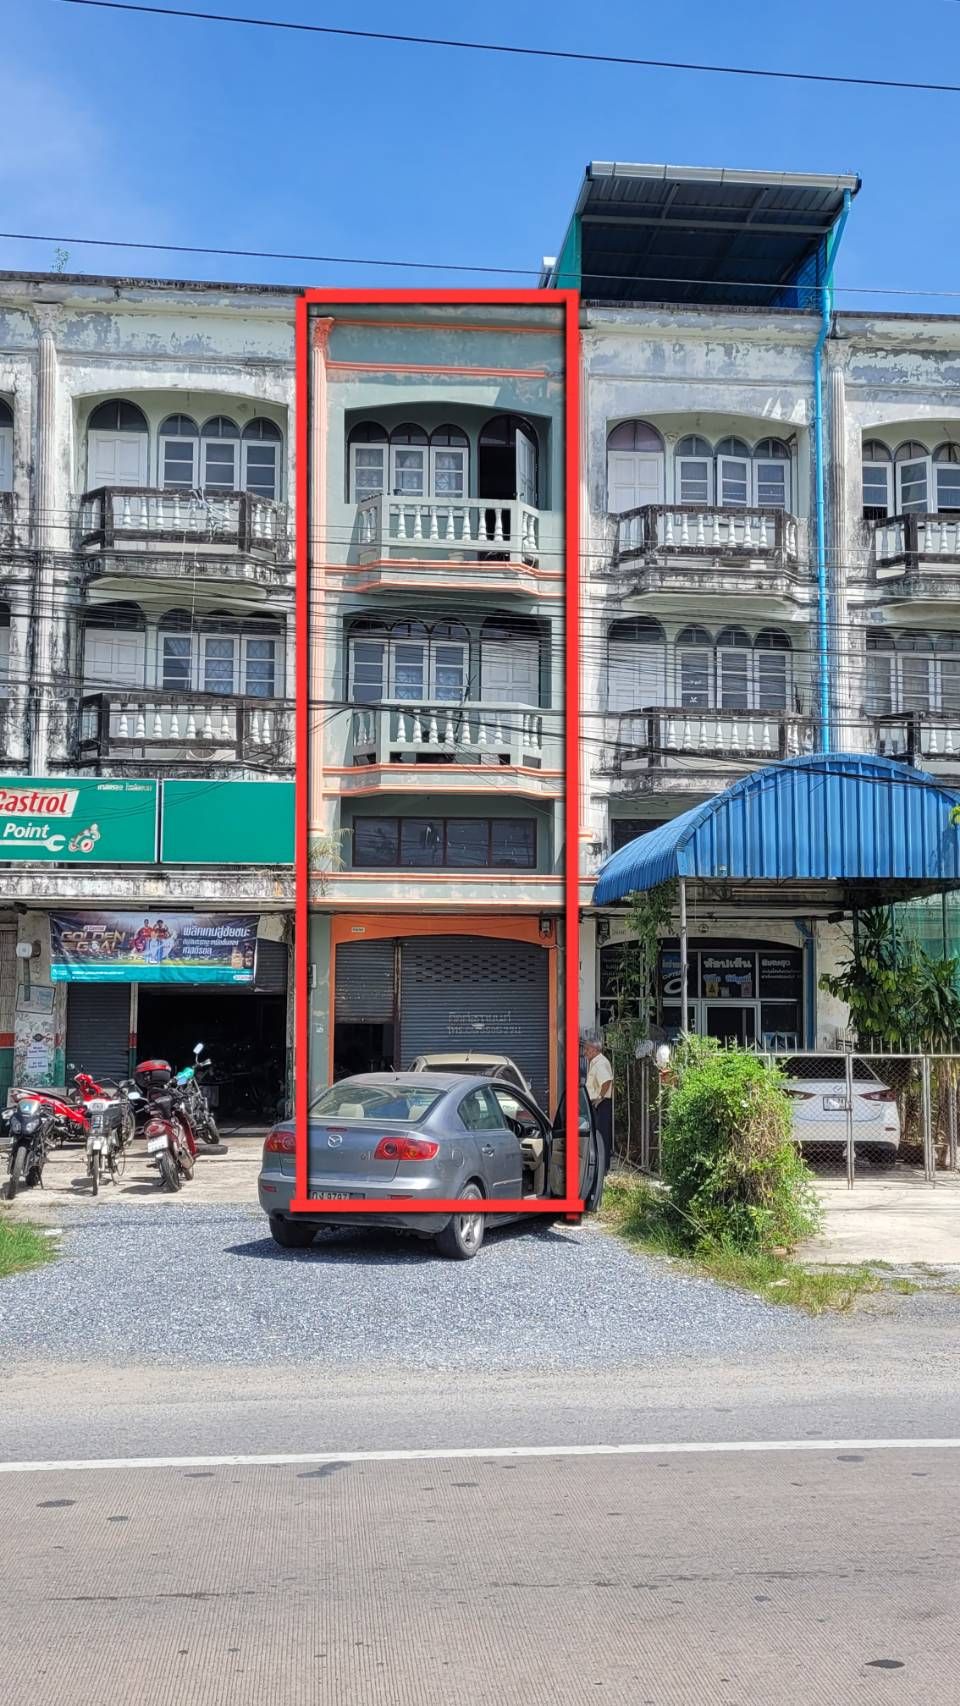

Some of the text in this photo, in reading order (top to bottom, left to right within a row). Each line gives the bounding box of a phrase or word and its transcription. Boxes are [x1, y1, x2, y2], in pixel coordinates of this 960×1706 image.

[3, 822, 50, 839] Point
[61, 929, 126, 942] GOLDEN
[76, 940, 118, 951] GOAL
